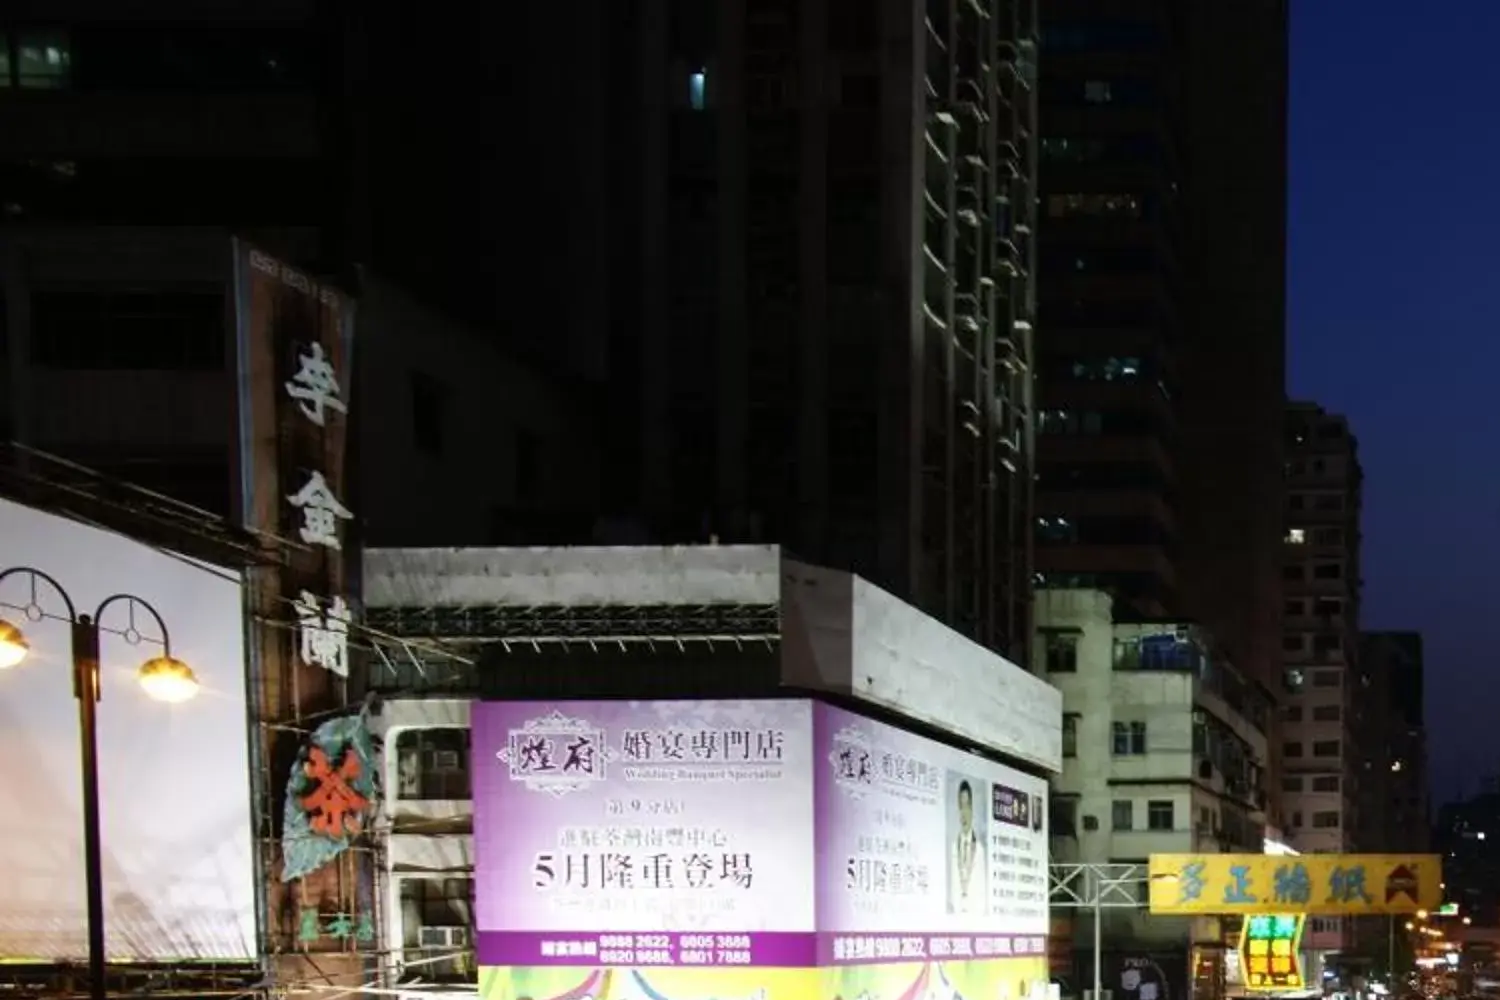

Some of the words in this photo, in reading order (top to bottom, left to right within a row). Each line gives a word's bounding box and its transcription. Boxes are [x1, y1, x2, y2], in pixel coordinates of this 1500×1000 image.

[623, 729, 784, 760] 婚宴專門店
[624, 767, 677, 784] Wedding
[678, 768, 725, 784] Banquet
[727, 768, 783, 784] Specialist
[533, 853, 754, 890] 5月隆重登場
